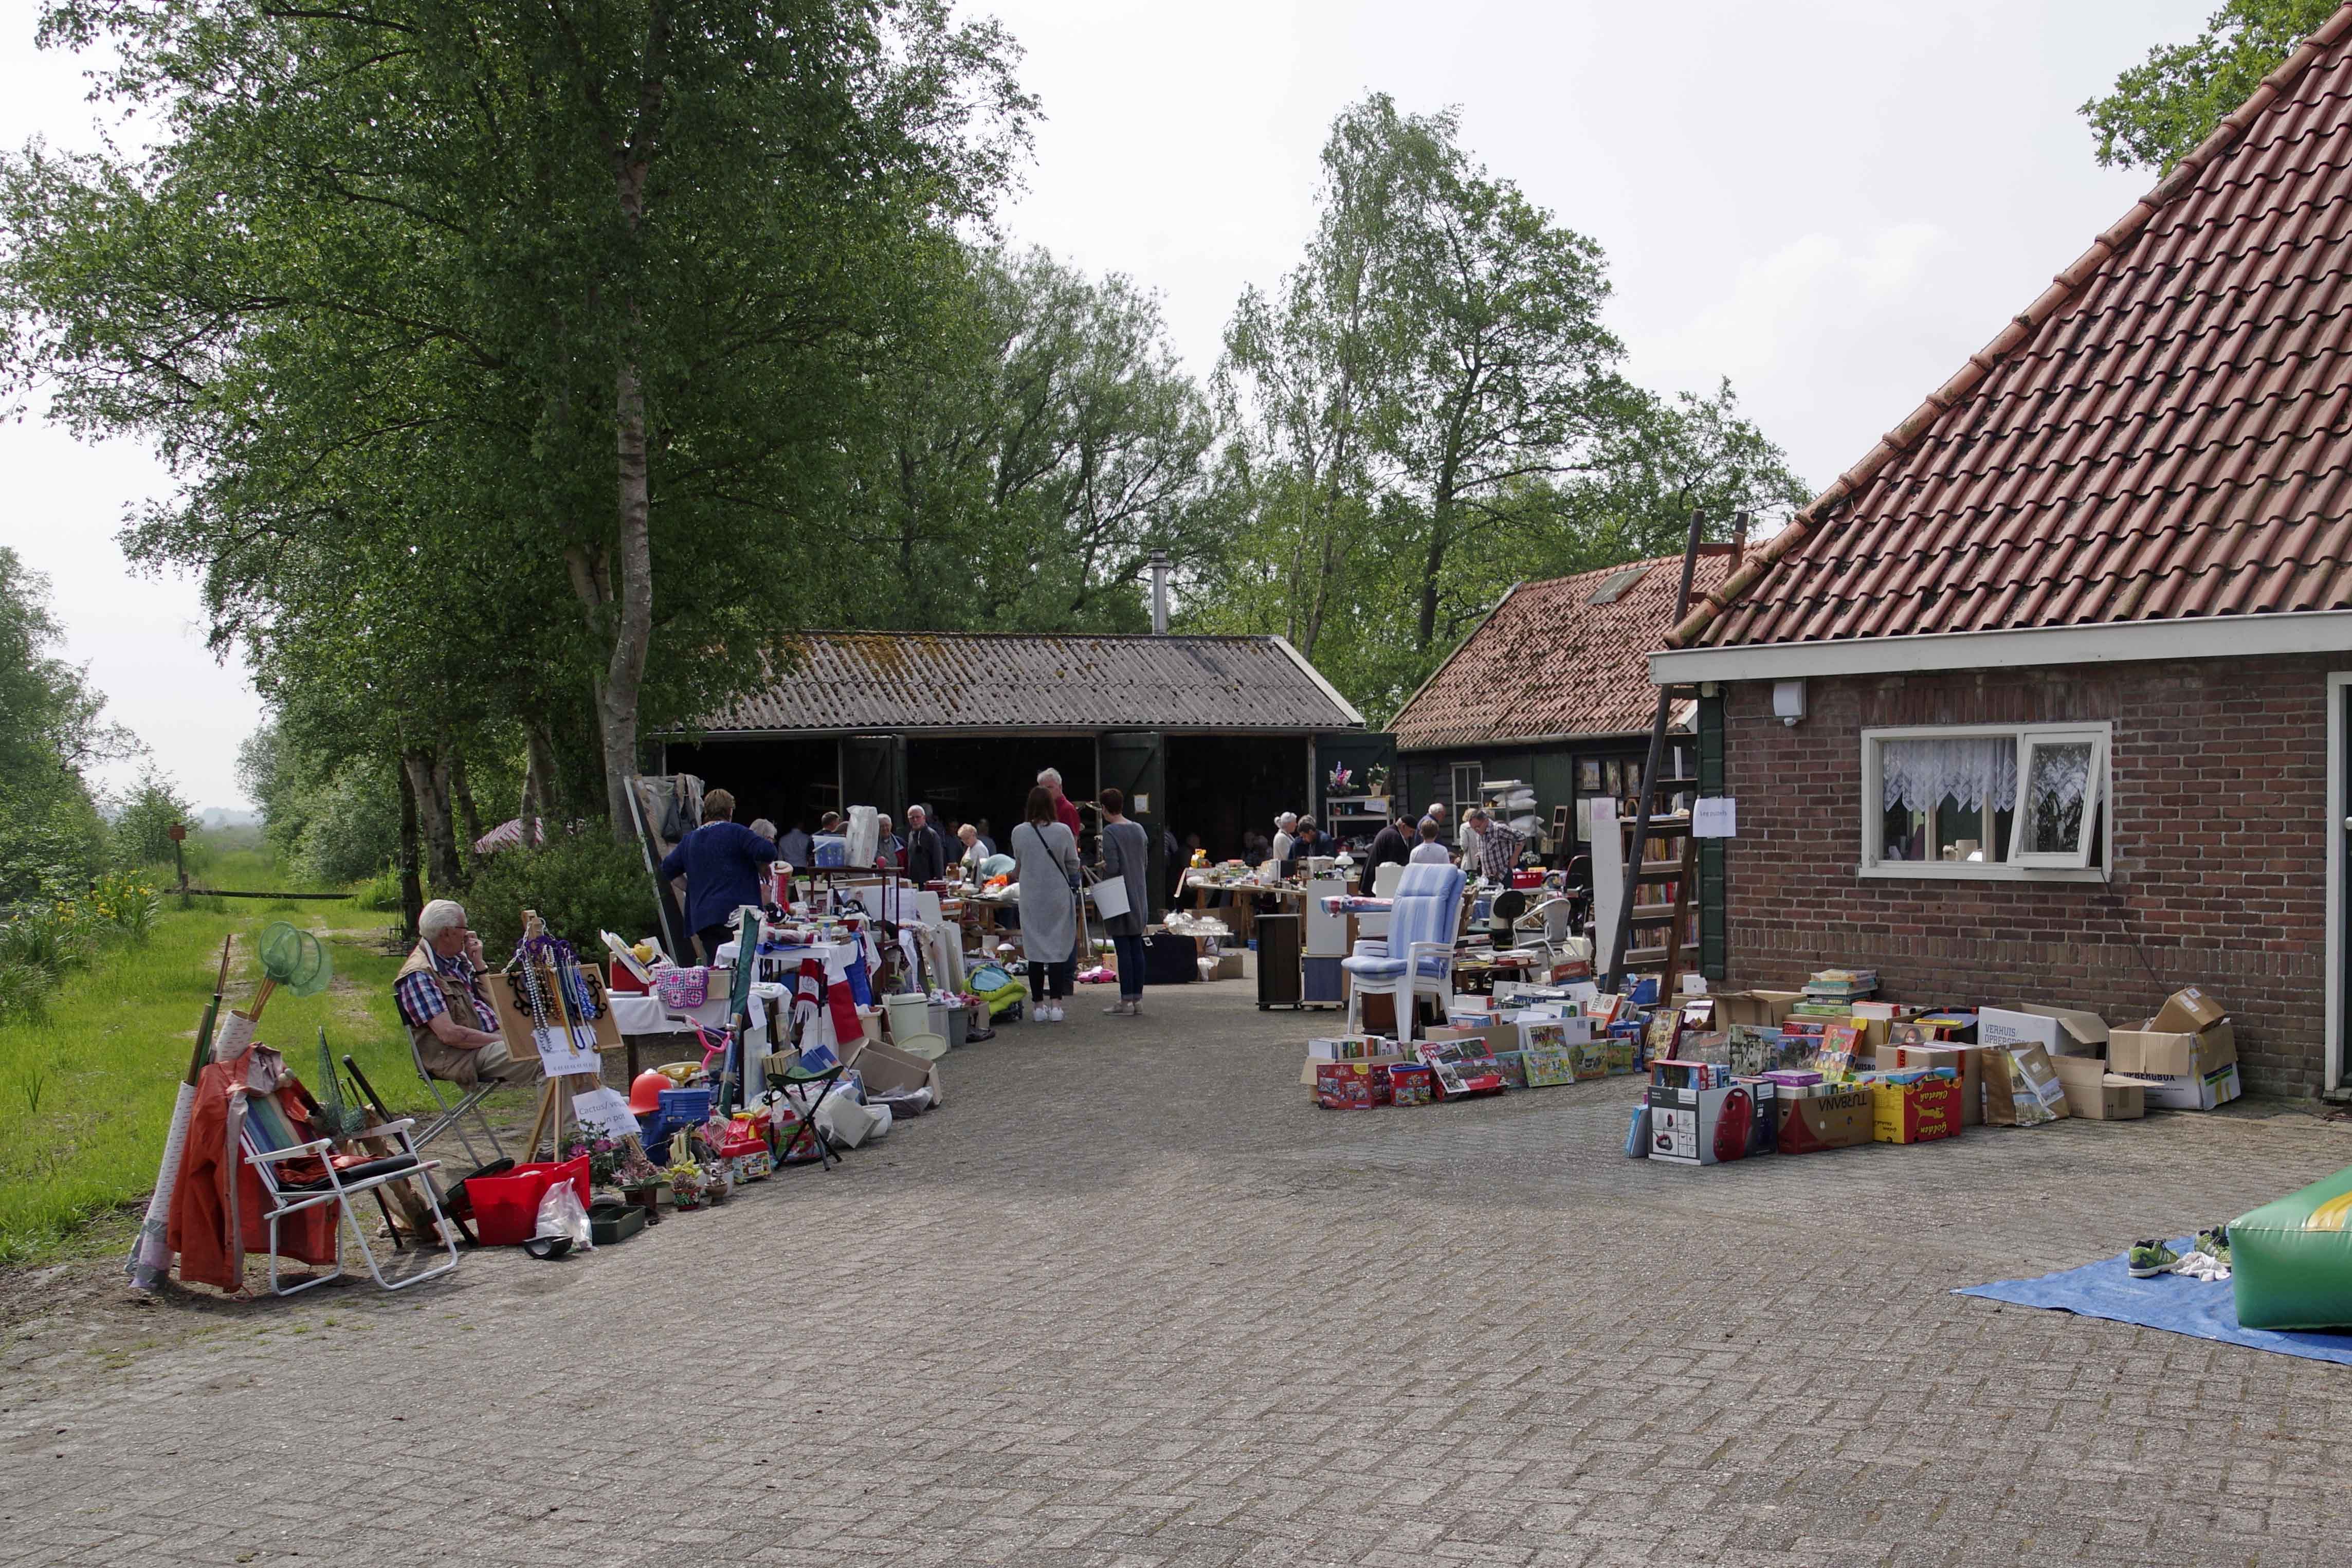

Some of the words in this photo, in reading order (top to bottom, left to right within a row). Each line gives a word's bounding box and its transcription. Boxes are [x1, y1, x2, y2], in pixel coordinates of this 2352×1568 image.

[1985, 1023, 2019, 1037] VERHUIS/
[1985, 1034, 2030, 1045] OPBERG
[1818, 1091, 1868, 1111] TURBANA
[1920, 1090, 1948, 1103] Cheetah
[579, 1101, 608, 1115] Cactus/
[613, 1113, 625, 1123] pot
[1920, 1121, 1947, 1136] Golden
